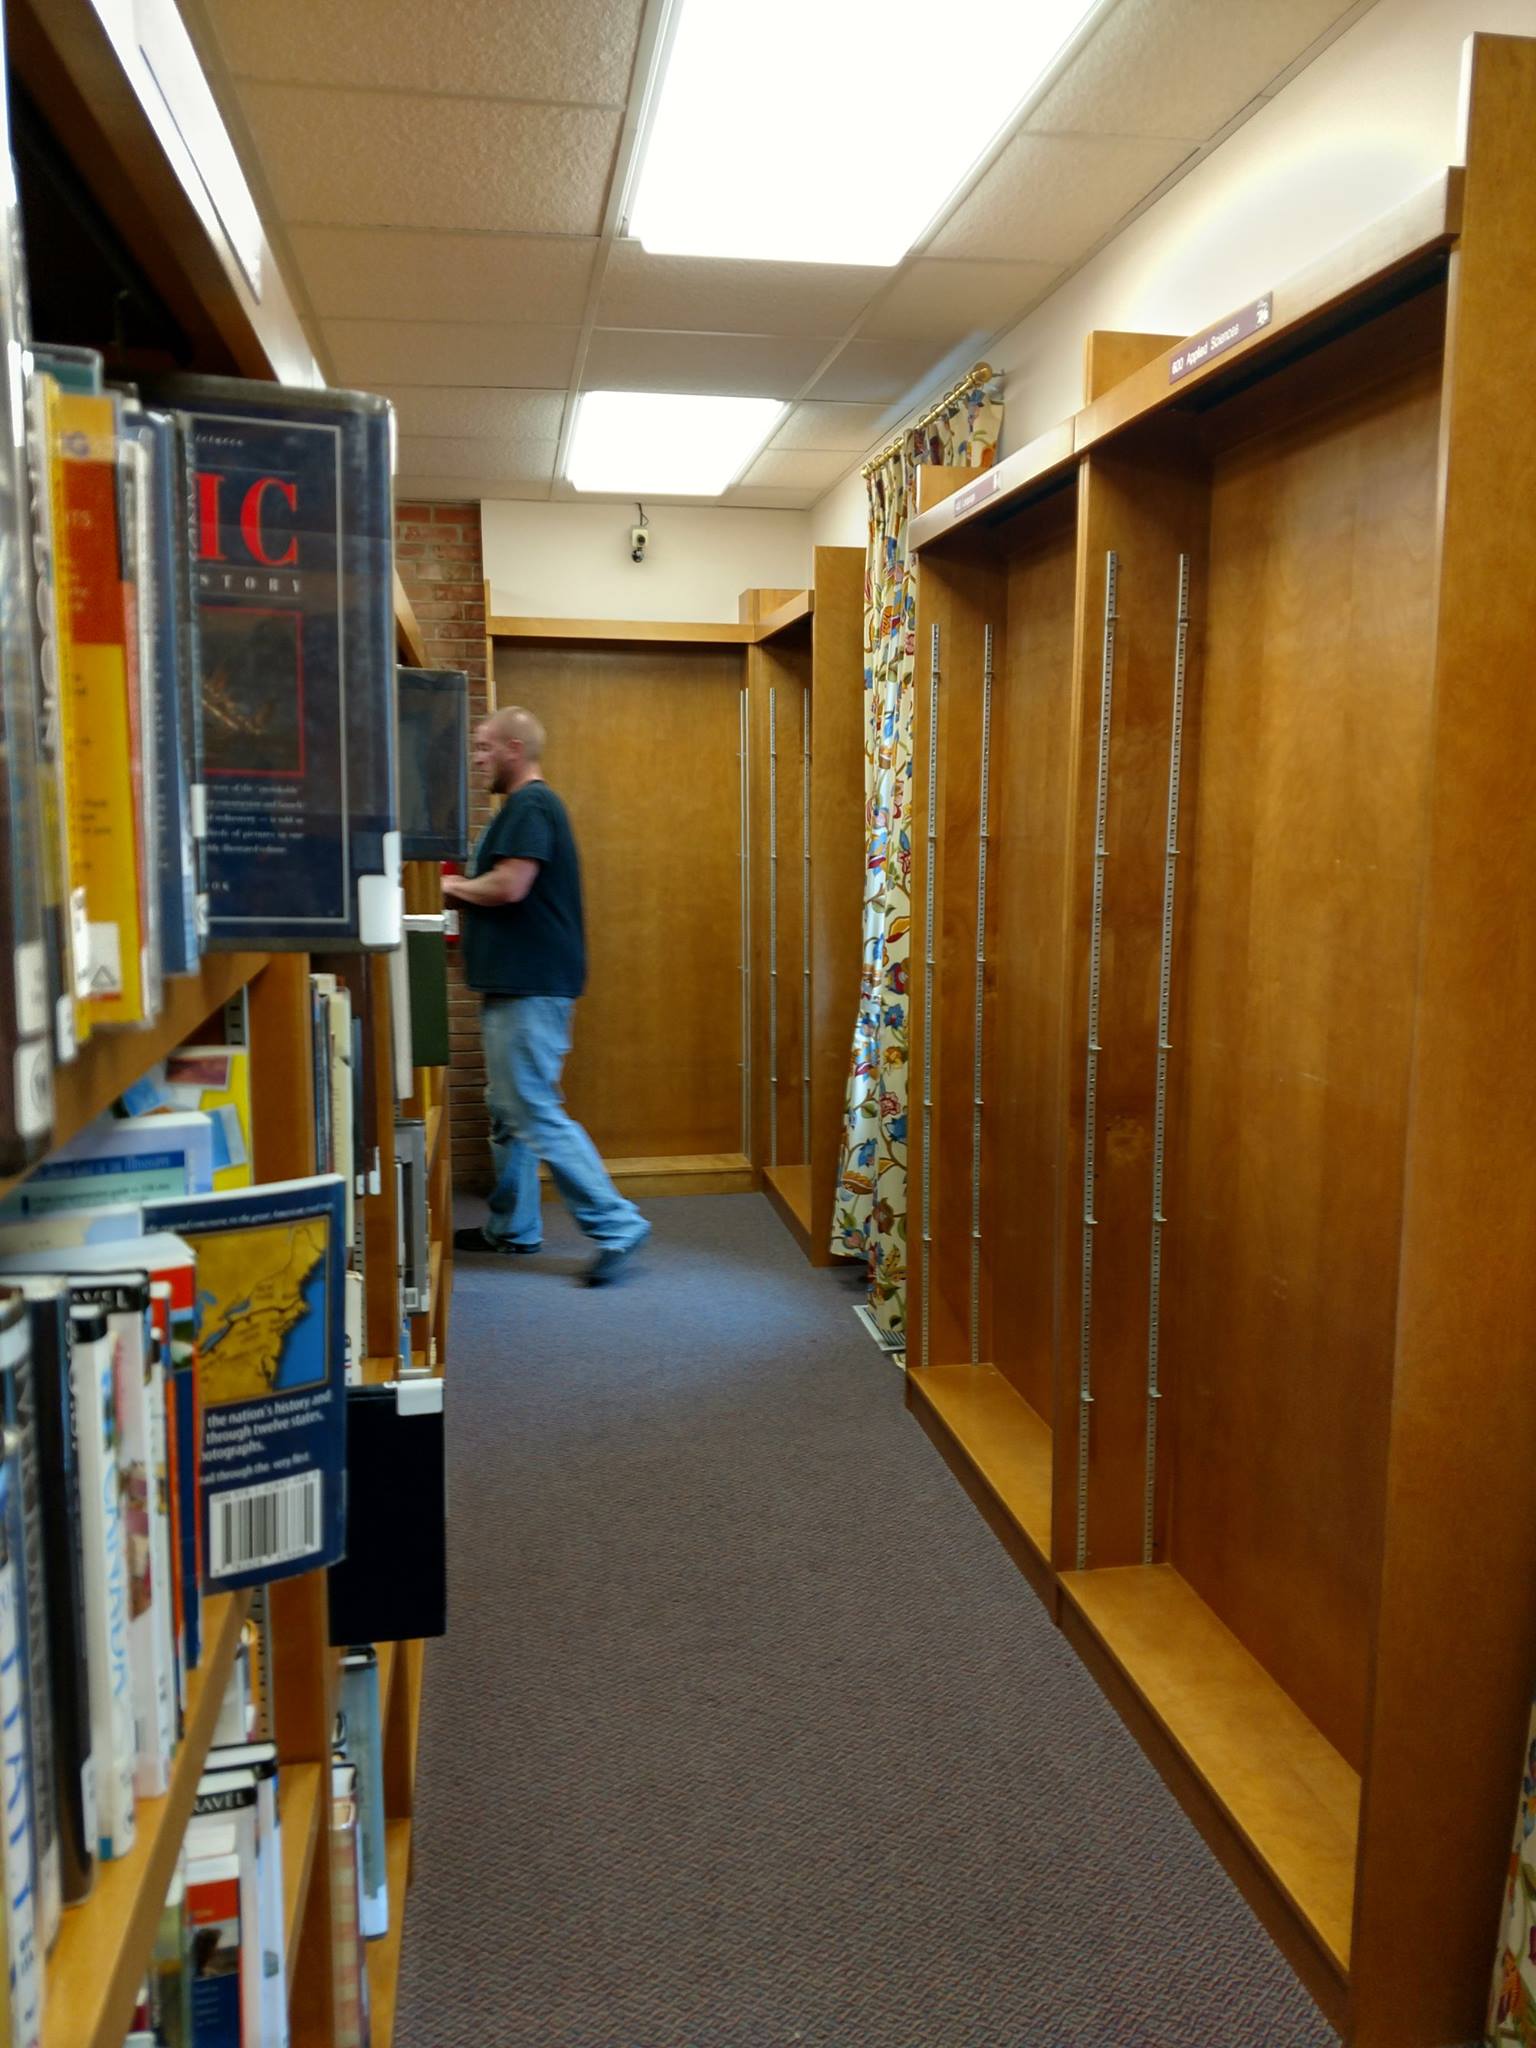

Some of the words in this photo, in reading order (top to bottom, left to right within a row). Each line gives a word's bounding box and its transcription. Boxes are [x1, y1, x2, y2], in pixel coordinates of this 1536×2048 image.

[1186, 340, 1208, 367] Applied
[1209, 322, 1240, 351] Sciences
[191, 471, 299, 568] IC
[207, 1413, 227, 1429] the
[228, 1404, 273, 1425] nation's
[274, 1397, 311, 1416] history
[311, 1389, 332, 1407] and
[206, 1423, 252, 1446] through
[253, 1417, 290, 1436] twelve
[202, 1440, 266, 1462] otographs.
[216, 1464, 253, 1480] through
[254, 1462, 270, 1473] the
[273, 1457, 291, 1470] very
